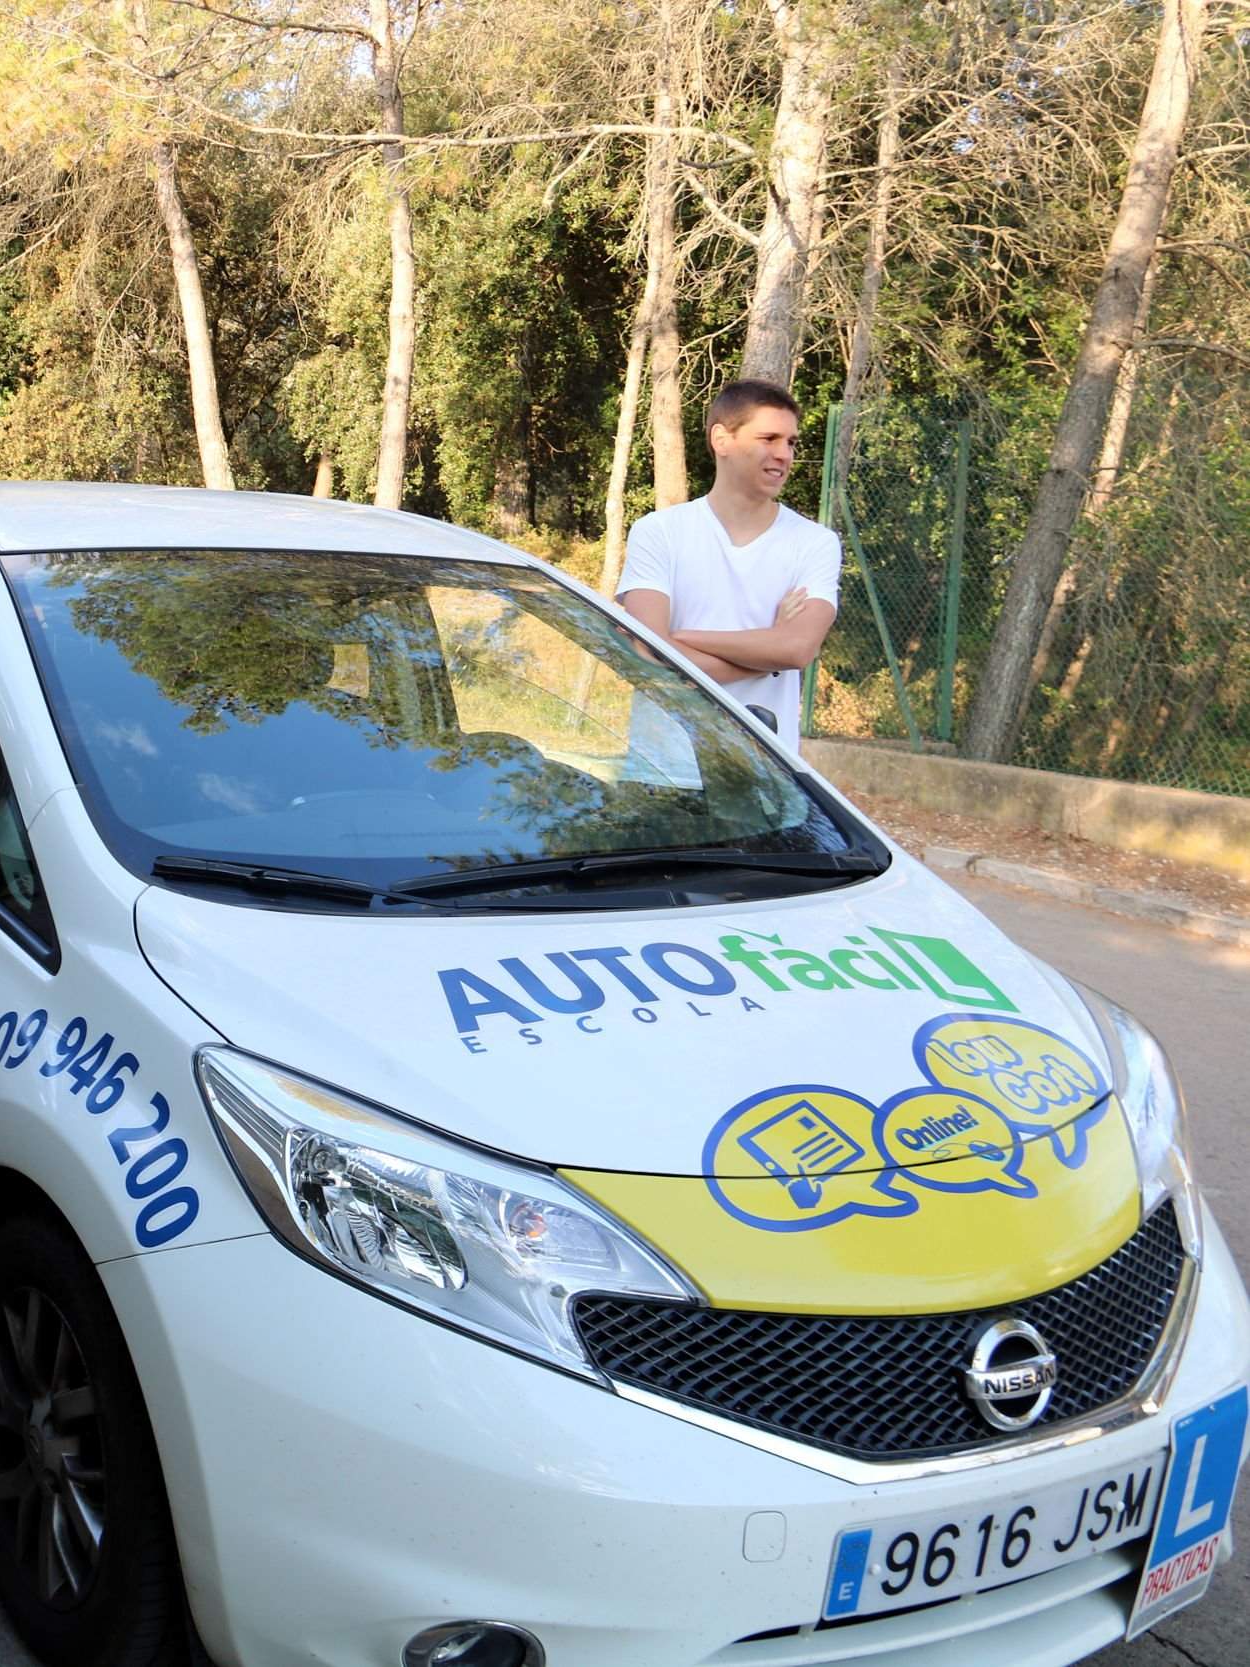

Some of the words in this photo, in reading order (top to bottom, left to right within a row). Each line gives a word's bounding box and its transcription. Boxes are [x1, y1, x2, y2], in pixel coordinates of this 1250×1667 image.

[460, 995, 766, 1055] ESCOLA
[39, 1016, 140, 1115] 946
[106, 1091, 200, 1249] 200
[894, 1103, 980, 1151] Online!
[983, 1366, 1055, 1394] NISSAN
[1173, 1434, 1215, 1538] L
[839, 1580, 854, 1601] E
[880, 1505, 1037, 1597] 9616
[1053, 1466, 1153, 1554] JSM
[1142, 1536, 1219, 1608] PRACTICAS
